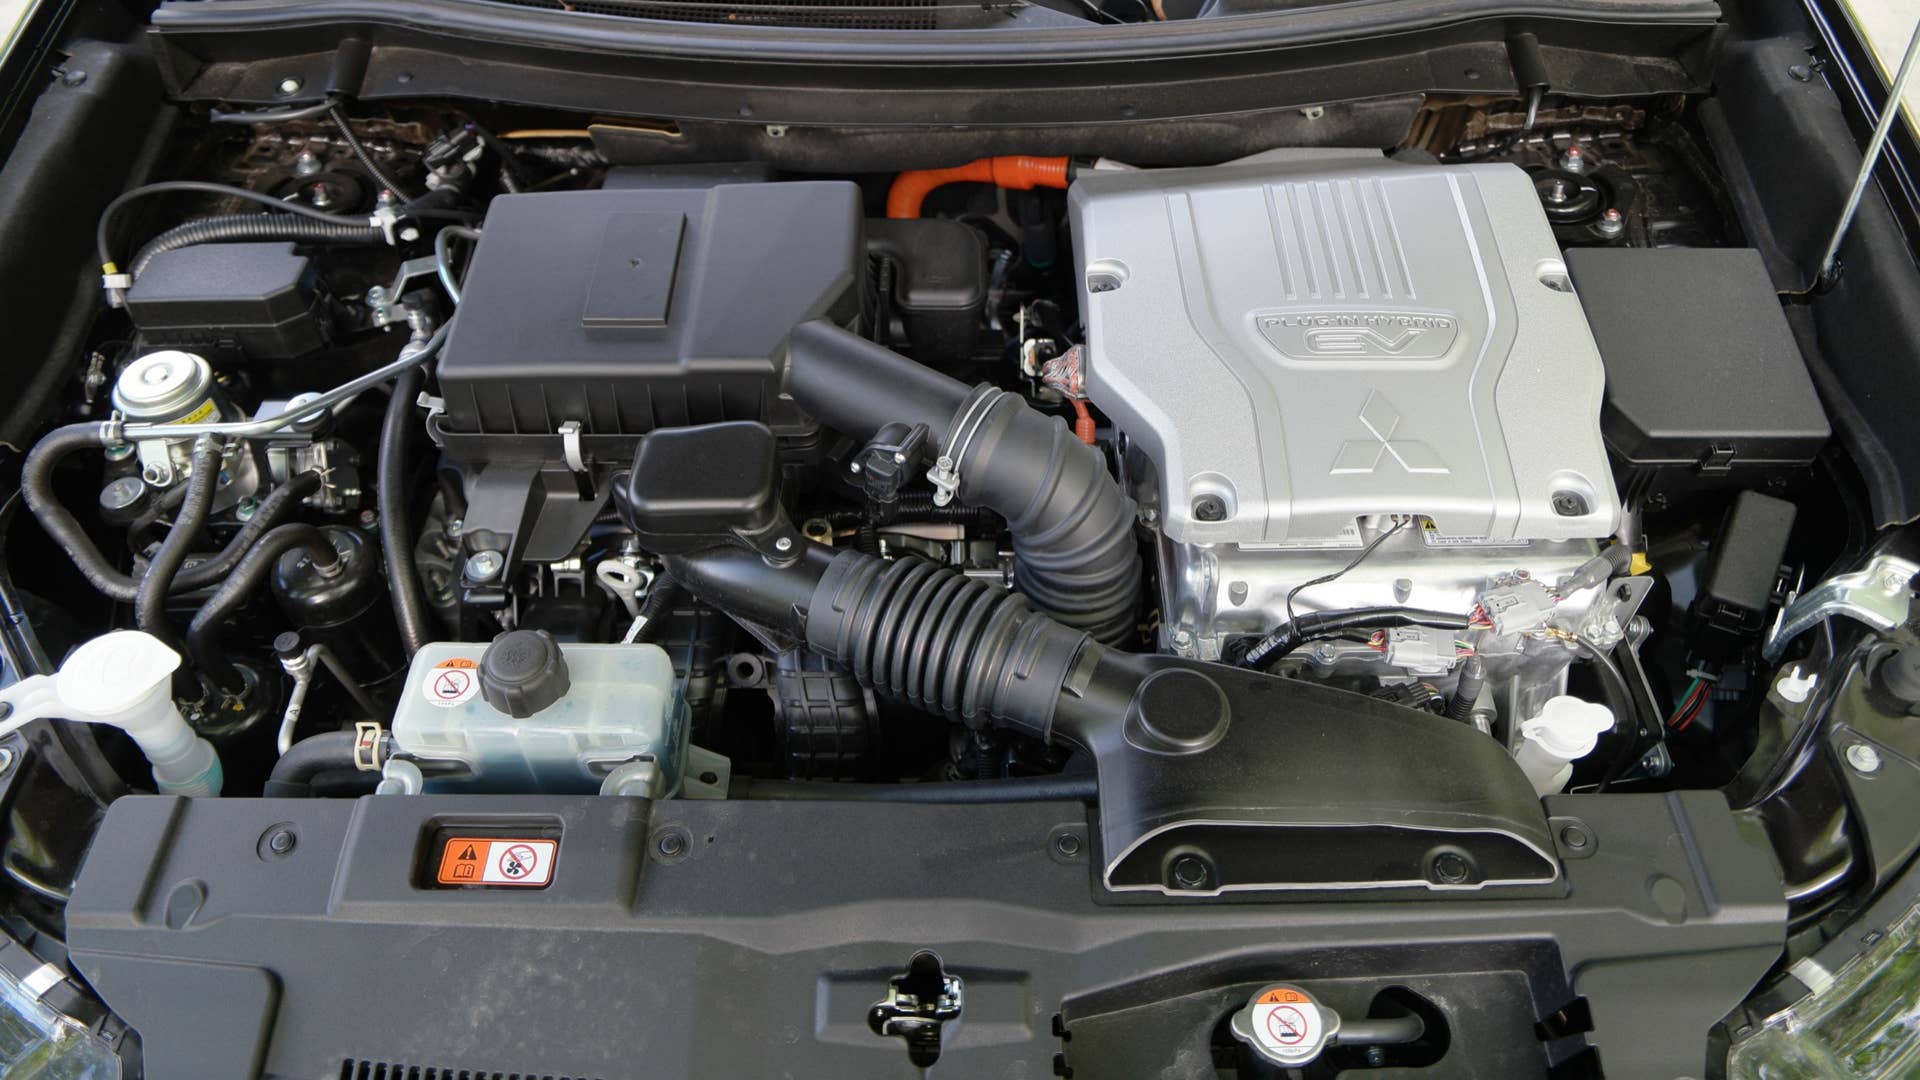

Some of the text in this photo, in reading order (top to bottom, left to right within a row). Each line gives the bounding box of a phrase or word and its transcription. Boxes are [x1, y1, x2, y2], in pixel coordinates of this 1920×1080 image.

[1264, 314, 1452, 329] PLUG-IN HYBRID
[1305, 327, 1429, 354] EV
